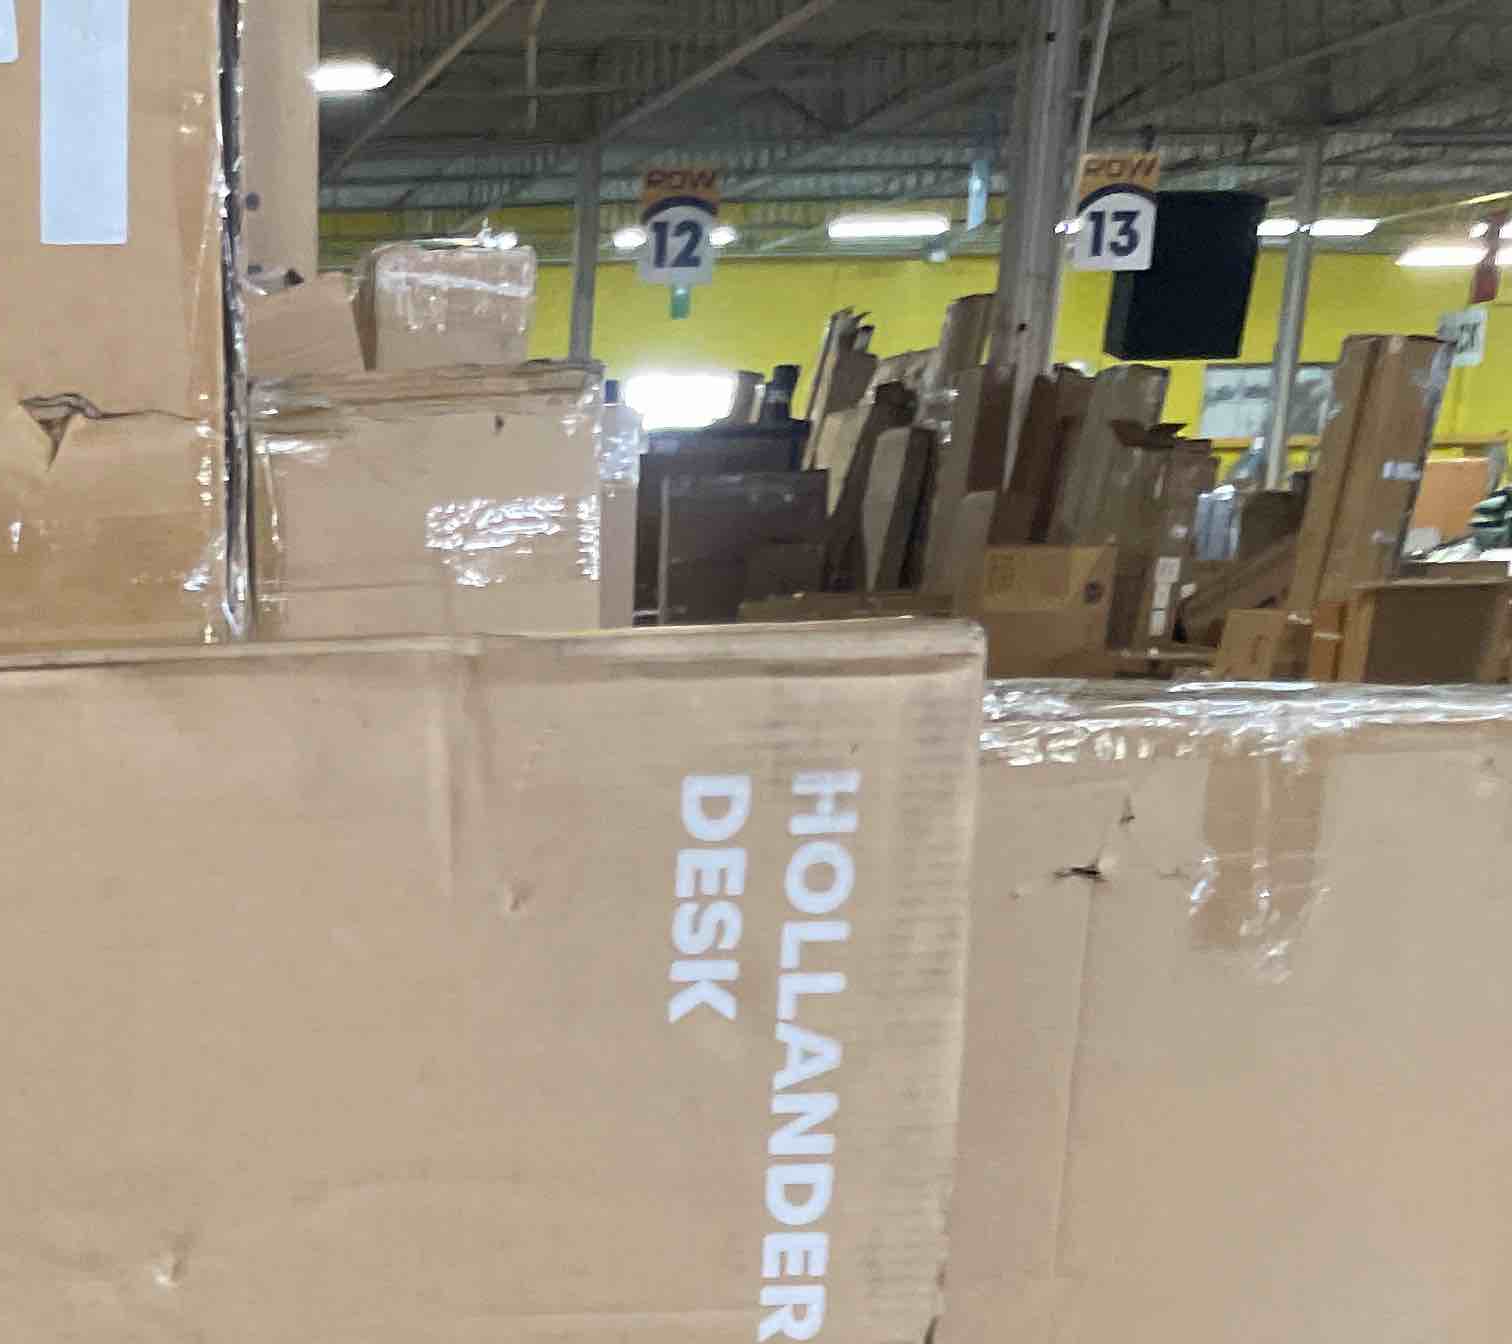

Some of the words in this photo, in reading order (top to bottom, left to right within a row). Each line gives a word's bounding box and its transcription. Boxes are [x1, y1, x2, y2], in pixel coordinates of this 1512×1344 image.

[651, 219, 703, 269] 12
[1087, 210, 1141, 257] 13
[668, 771, 752, 1024] DESK
[756, 768, 861, 1344] HOLLANDER
